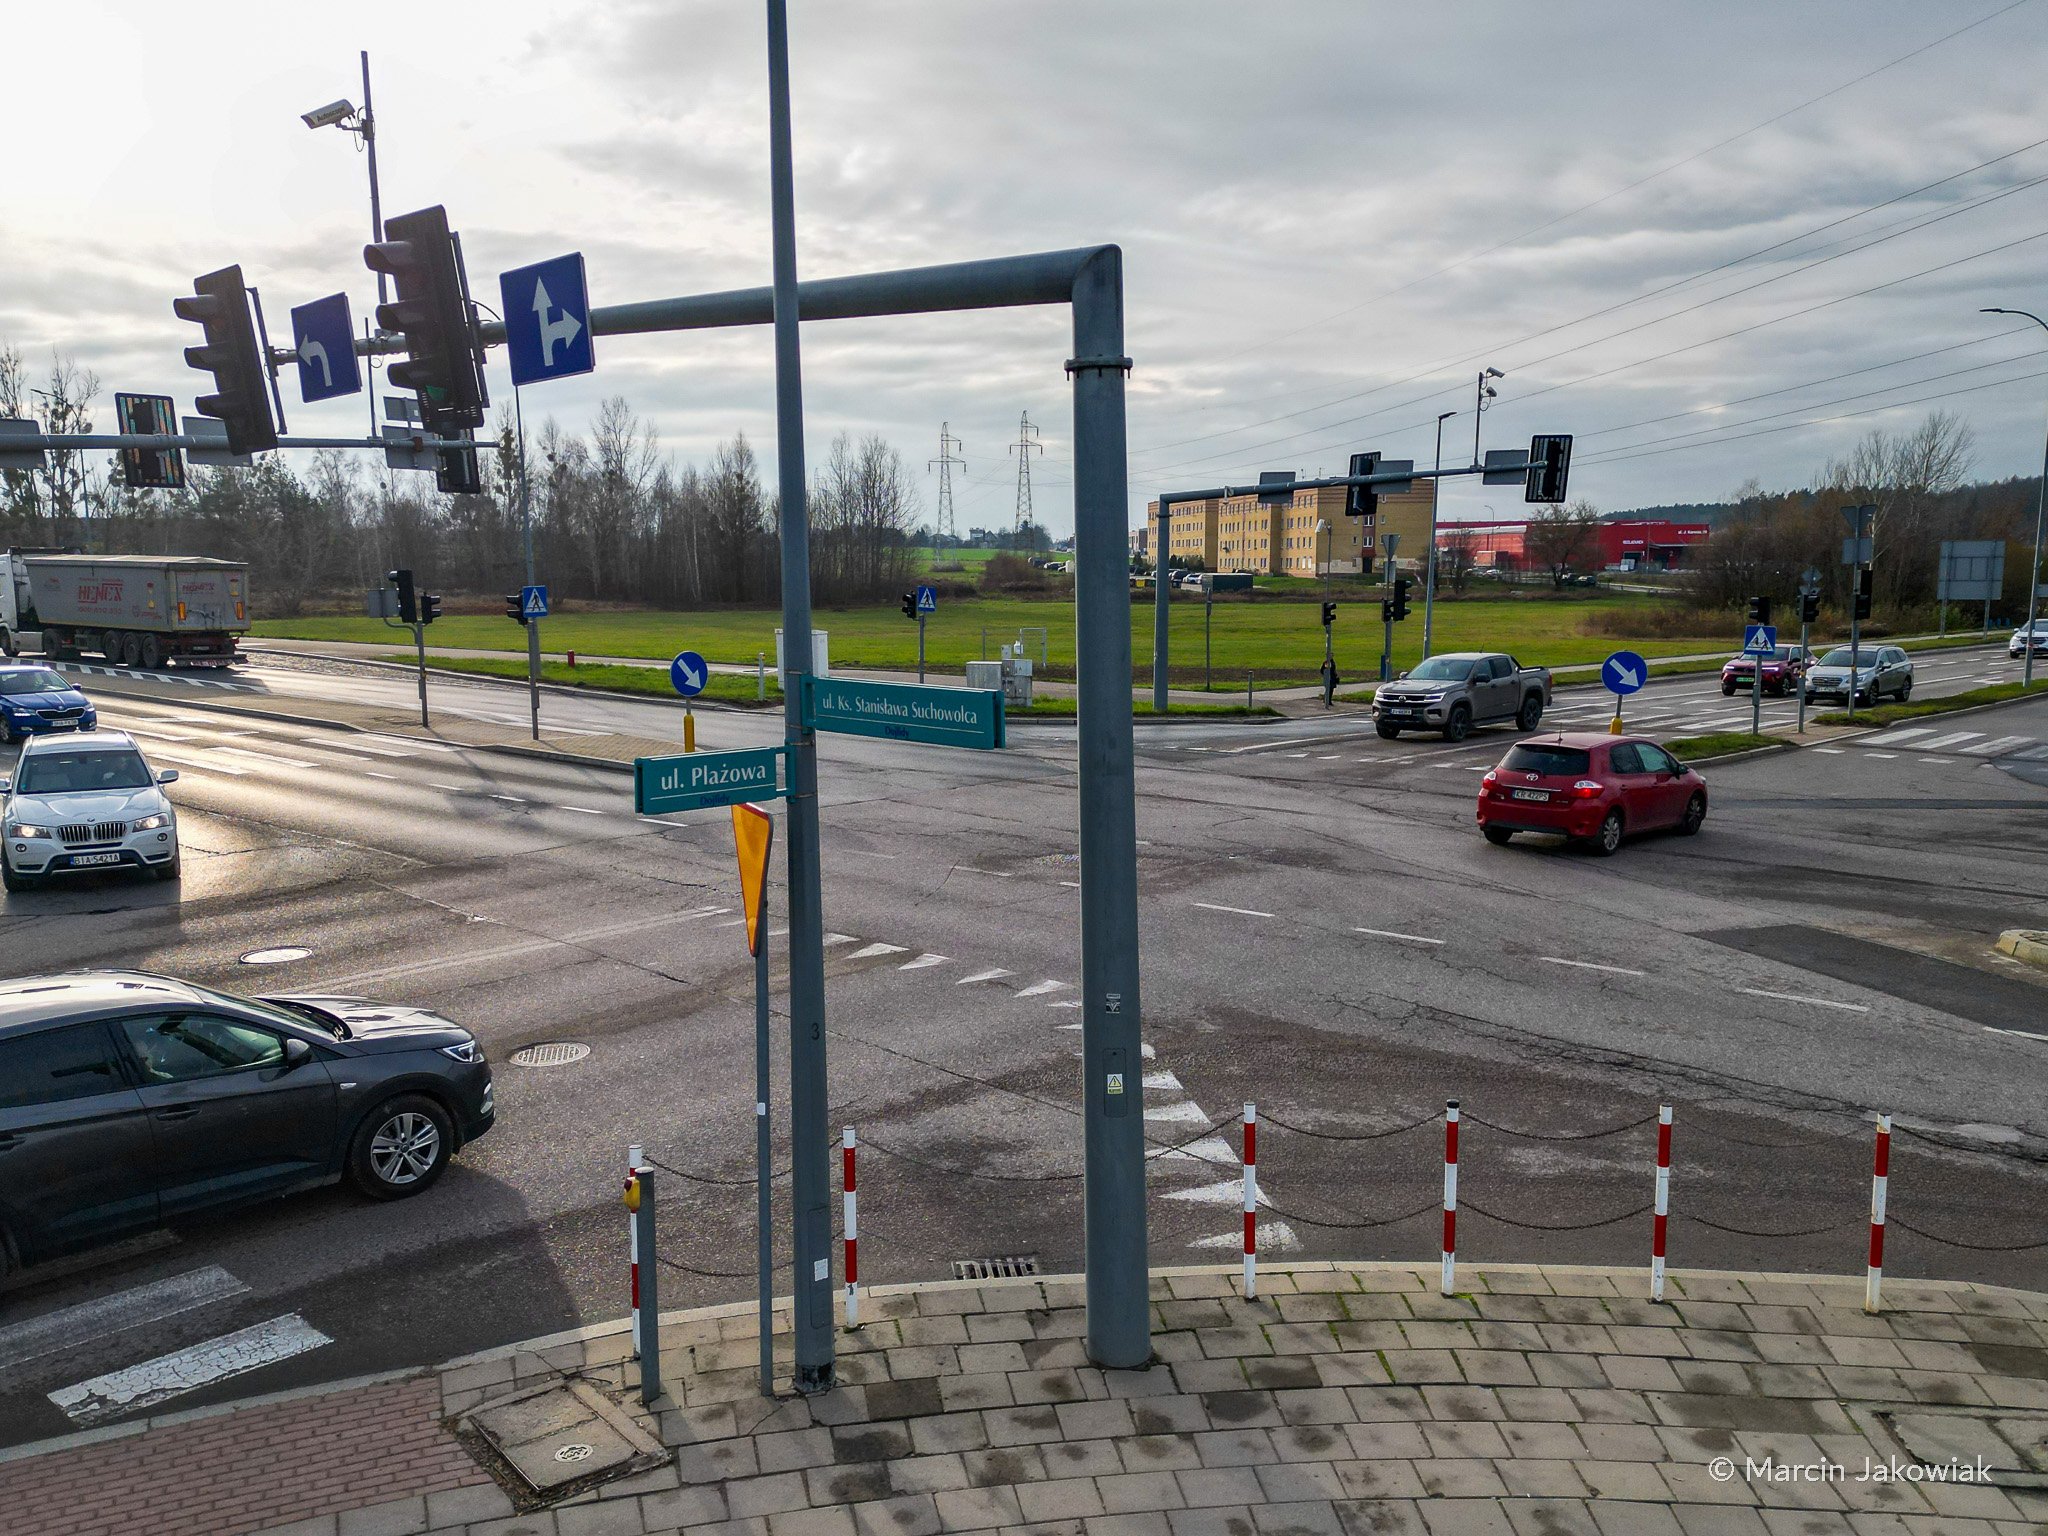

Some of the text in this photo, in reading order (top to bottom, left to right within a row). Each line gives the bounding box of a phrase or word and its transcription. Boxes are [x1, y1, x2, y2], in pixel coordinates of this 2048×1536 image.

[823, 692, 977, 724] ul. Ks. Stanisława Suchowolca
[885, 726, 909, 738] Dojlidy
[661, 763, 766, 790] ul. Plażowa
[700, 794, 730, 807] Dojlidy
[1515, 790, 1527, 798] KR
[74, 856, 91, 865] BIA
[811, 1022, 820, 1040] 3
